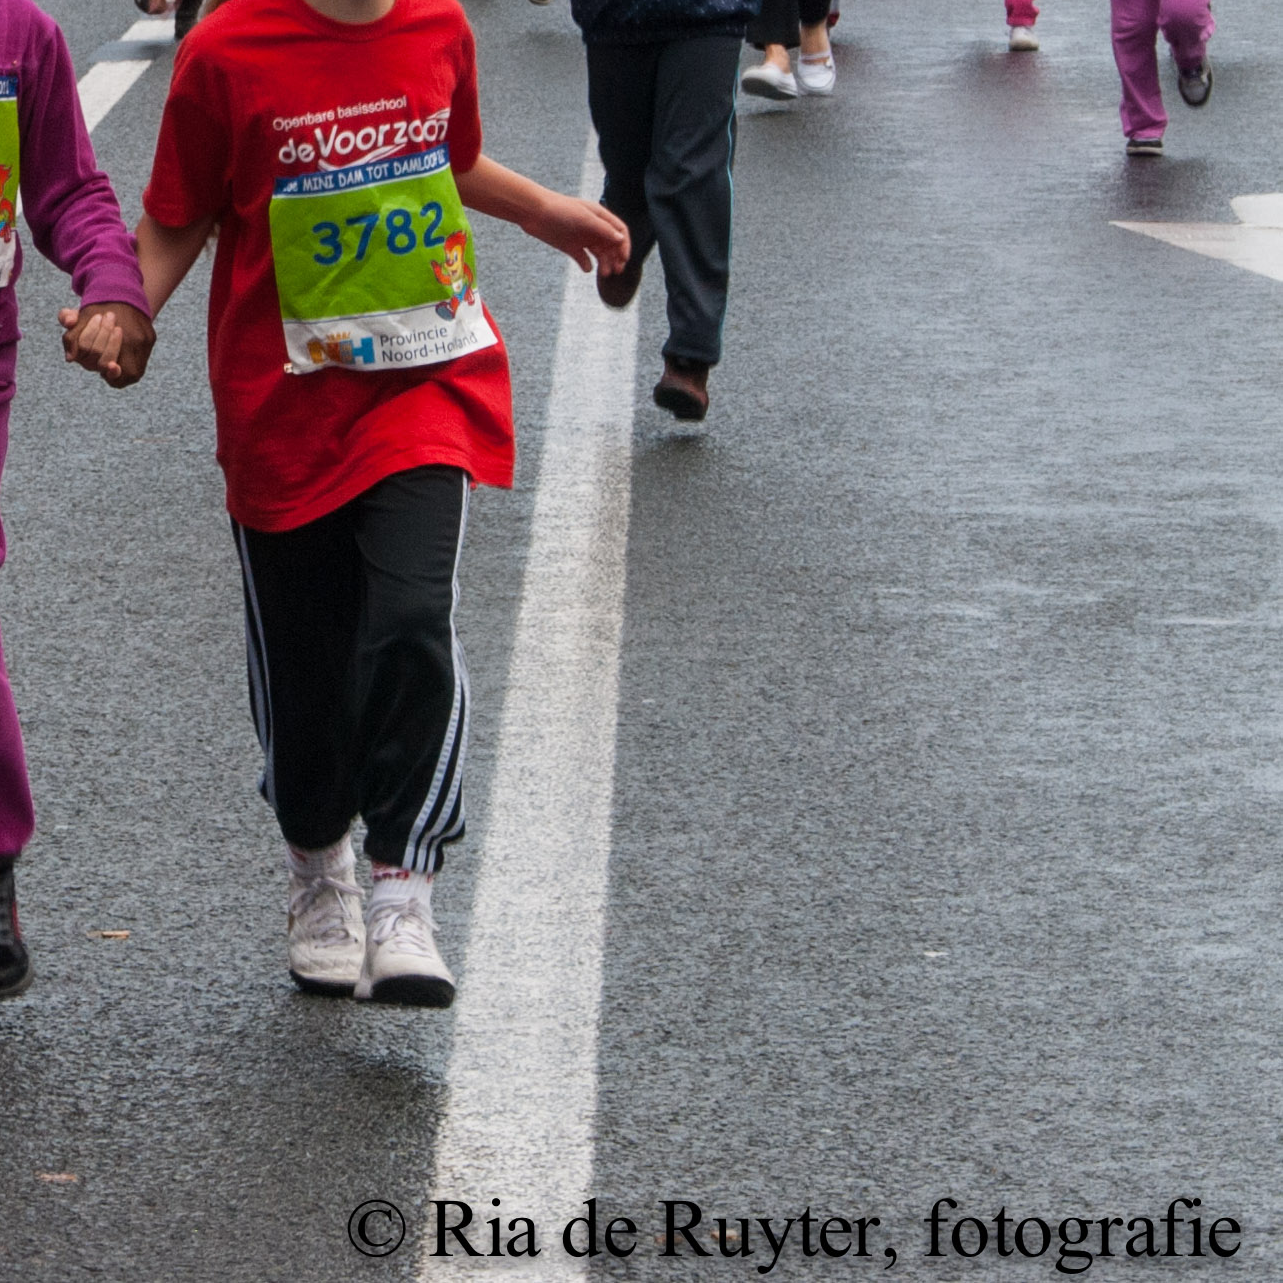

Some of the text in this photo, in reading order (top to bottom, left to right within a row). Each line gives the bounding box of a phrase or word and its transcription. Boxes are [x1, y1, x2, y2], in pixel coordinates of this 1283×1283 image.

[272, 95, 408, 132] Openbare basisschool
[303, 177, 335, 192] MINI
[338, 171, 365, 187] DAM
[366, 164, 390, 180] TOT
[312, 201, 446, 266] 3782
[379, 325, 448, 348] Provincie
